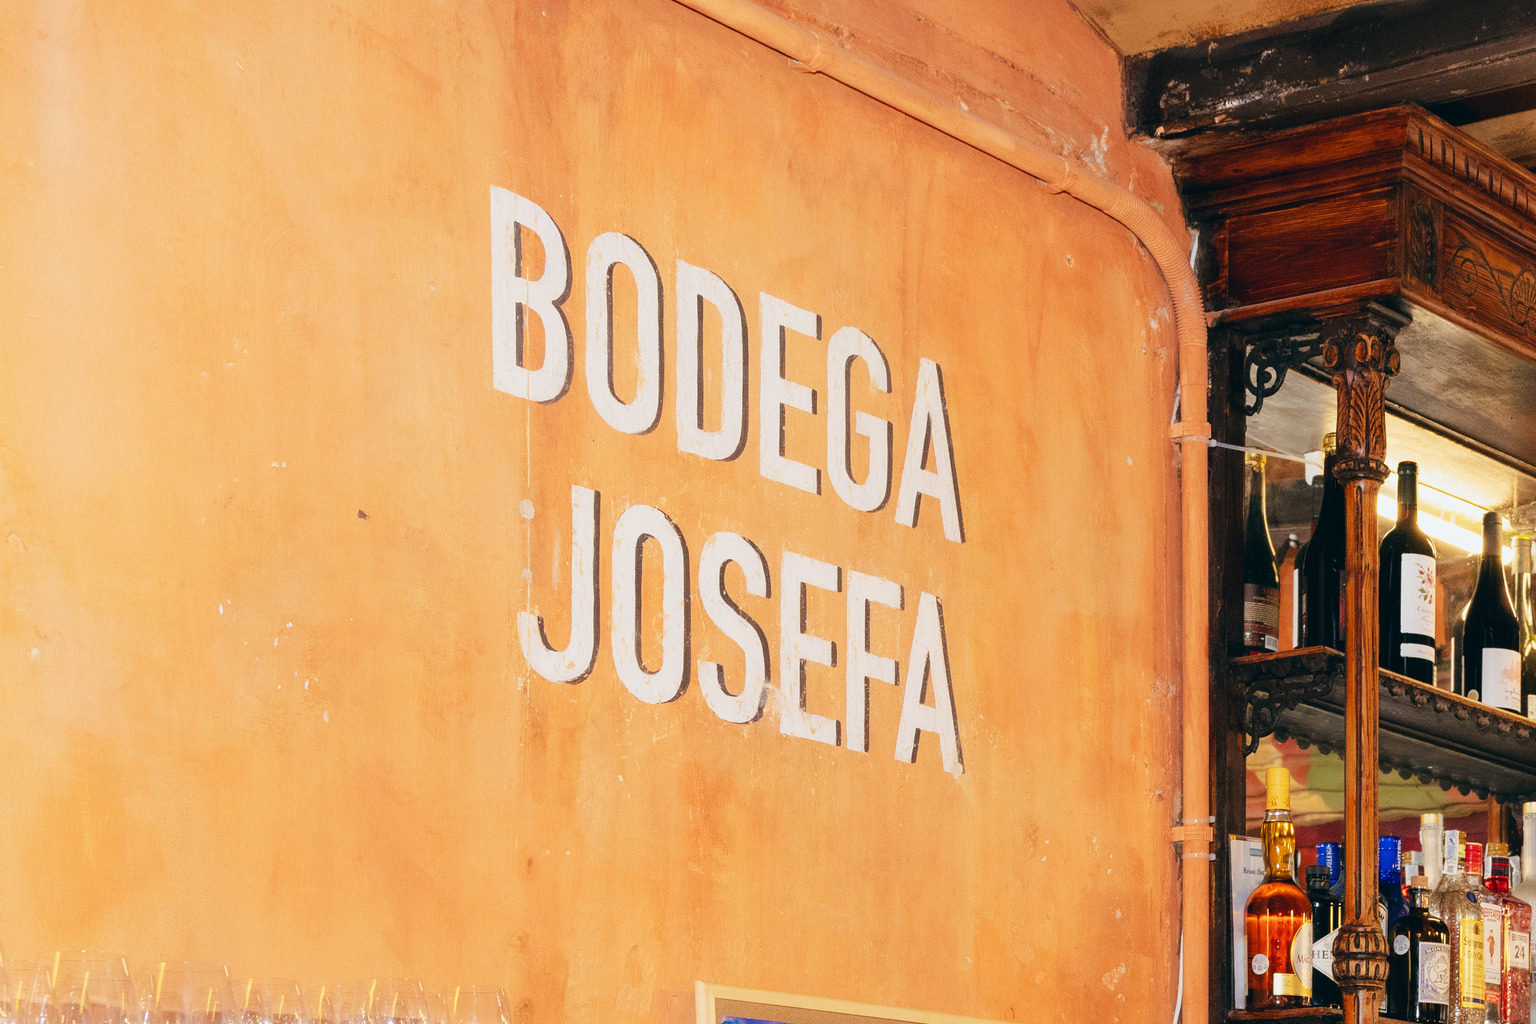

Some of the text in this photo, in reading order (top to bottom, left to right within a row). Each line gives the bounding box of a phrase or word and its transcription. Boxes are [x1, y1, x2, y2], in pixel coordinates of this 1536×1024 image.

[490, 184, 965, 543] BODEGA
[517, 485, 965, 775] JOSEFA
[1514, 945, 1526, 960] 24
